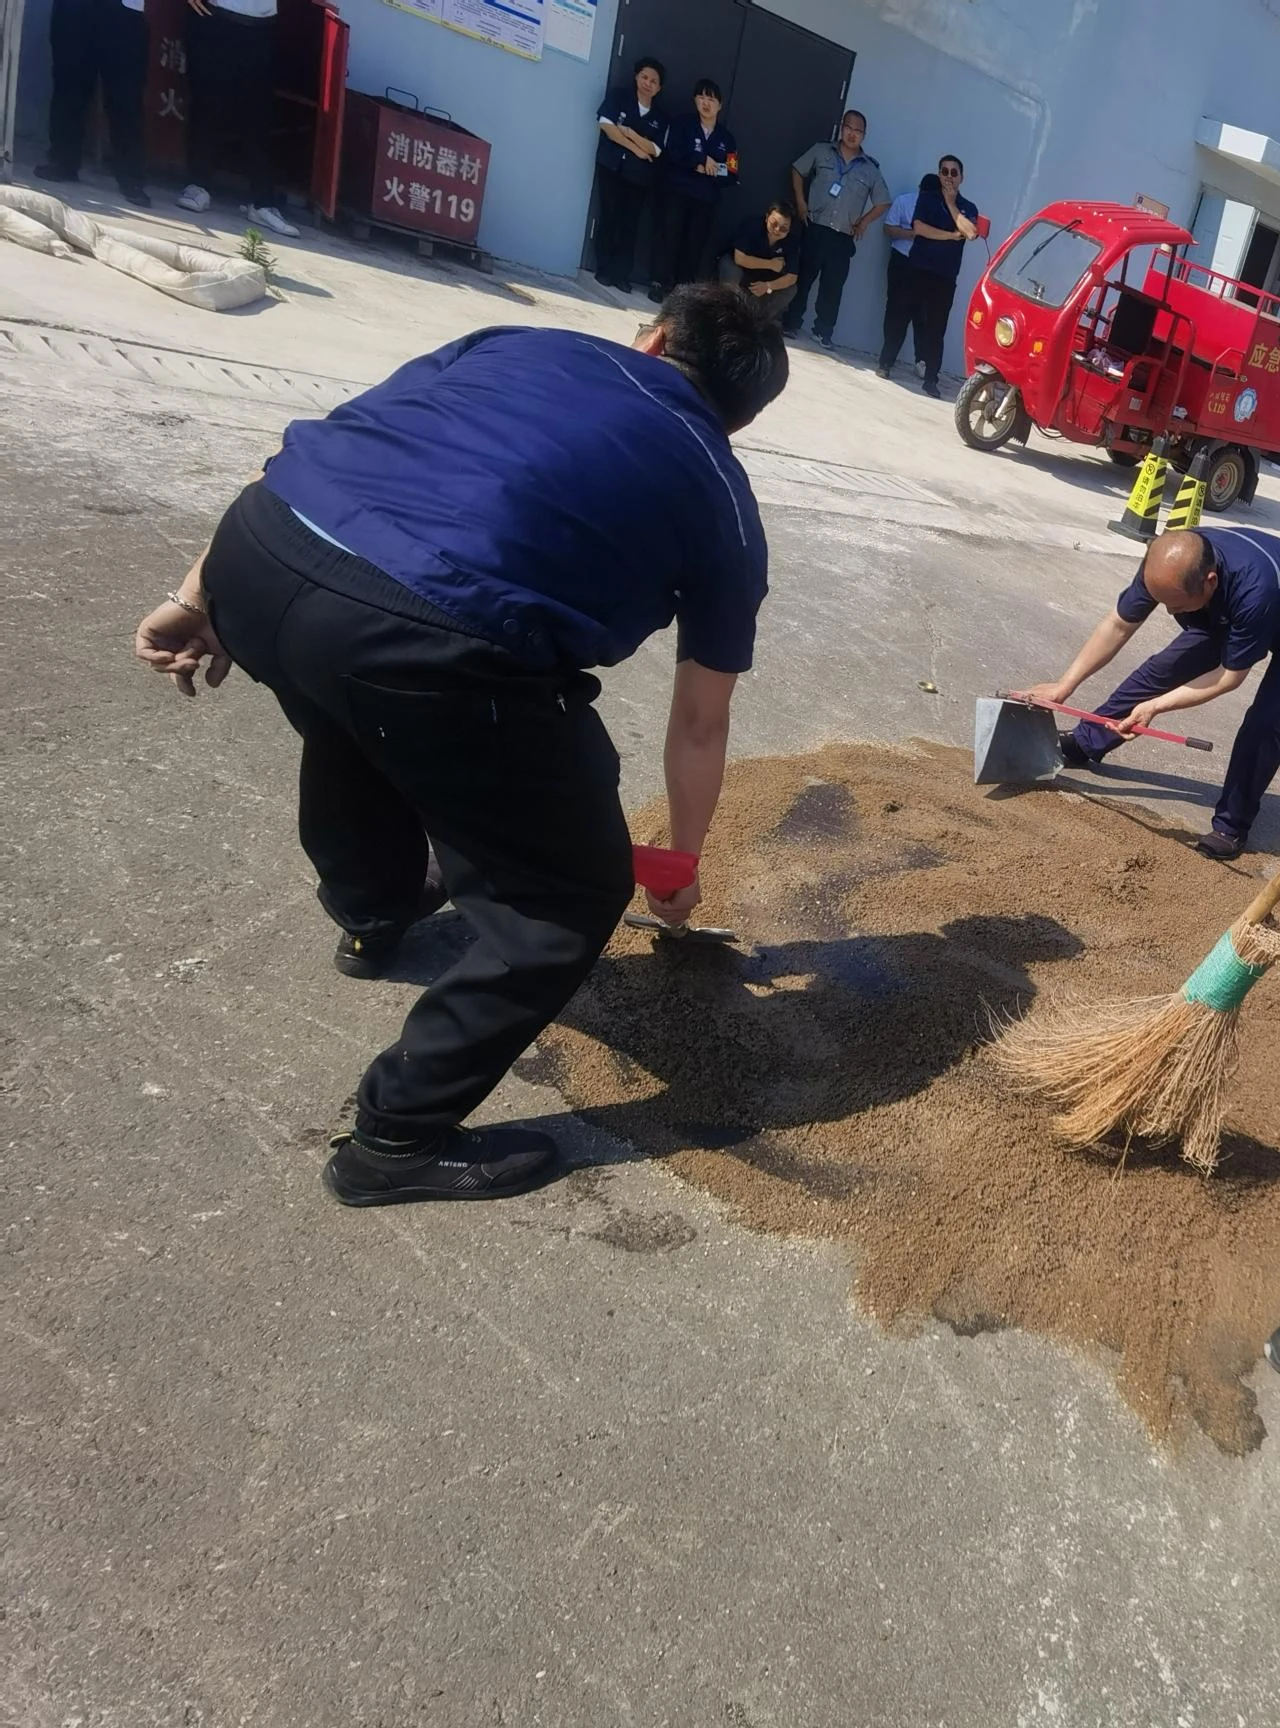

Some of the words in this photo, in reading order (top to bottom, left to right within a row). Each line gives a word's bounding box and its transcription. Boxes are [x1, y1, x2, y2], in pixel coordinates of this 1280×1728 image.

[386, 130, 482, 185] 消防器材
[383, 176, 475, 223] 火警119
